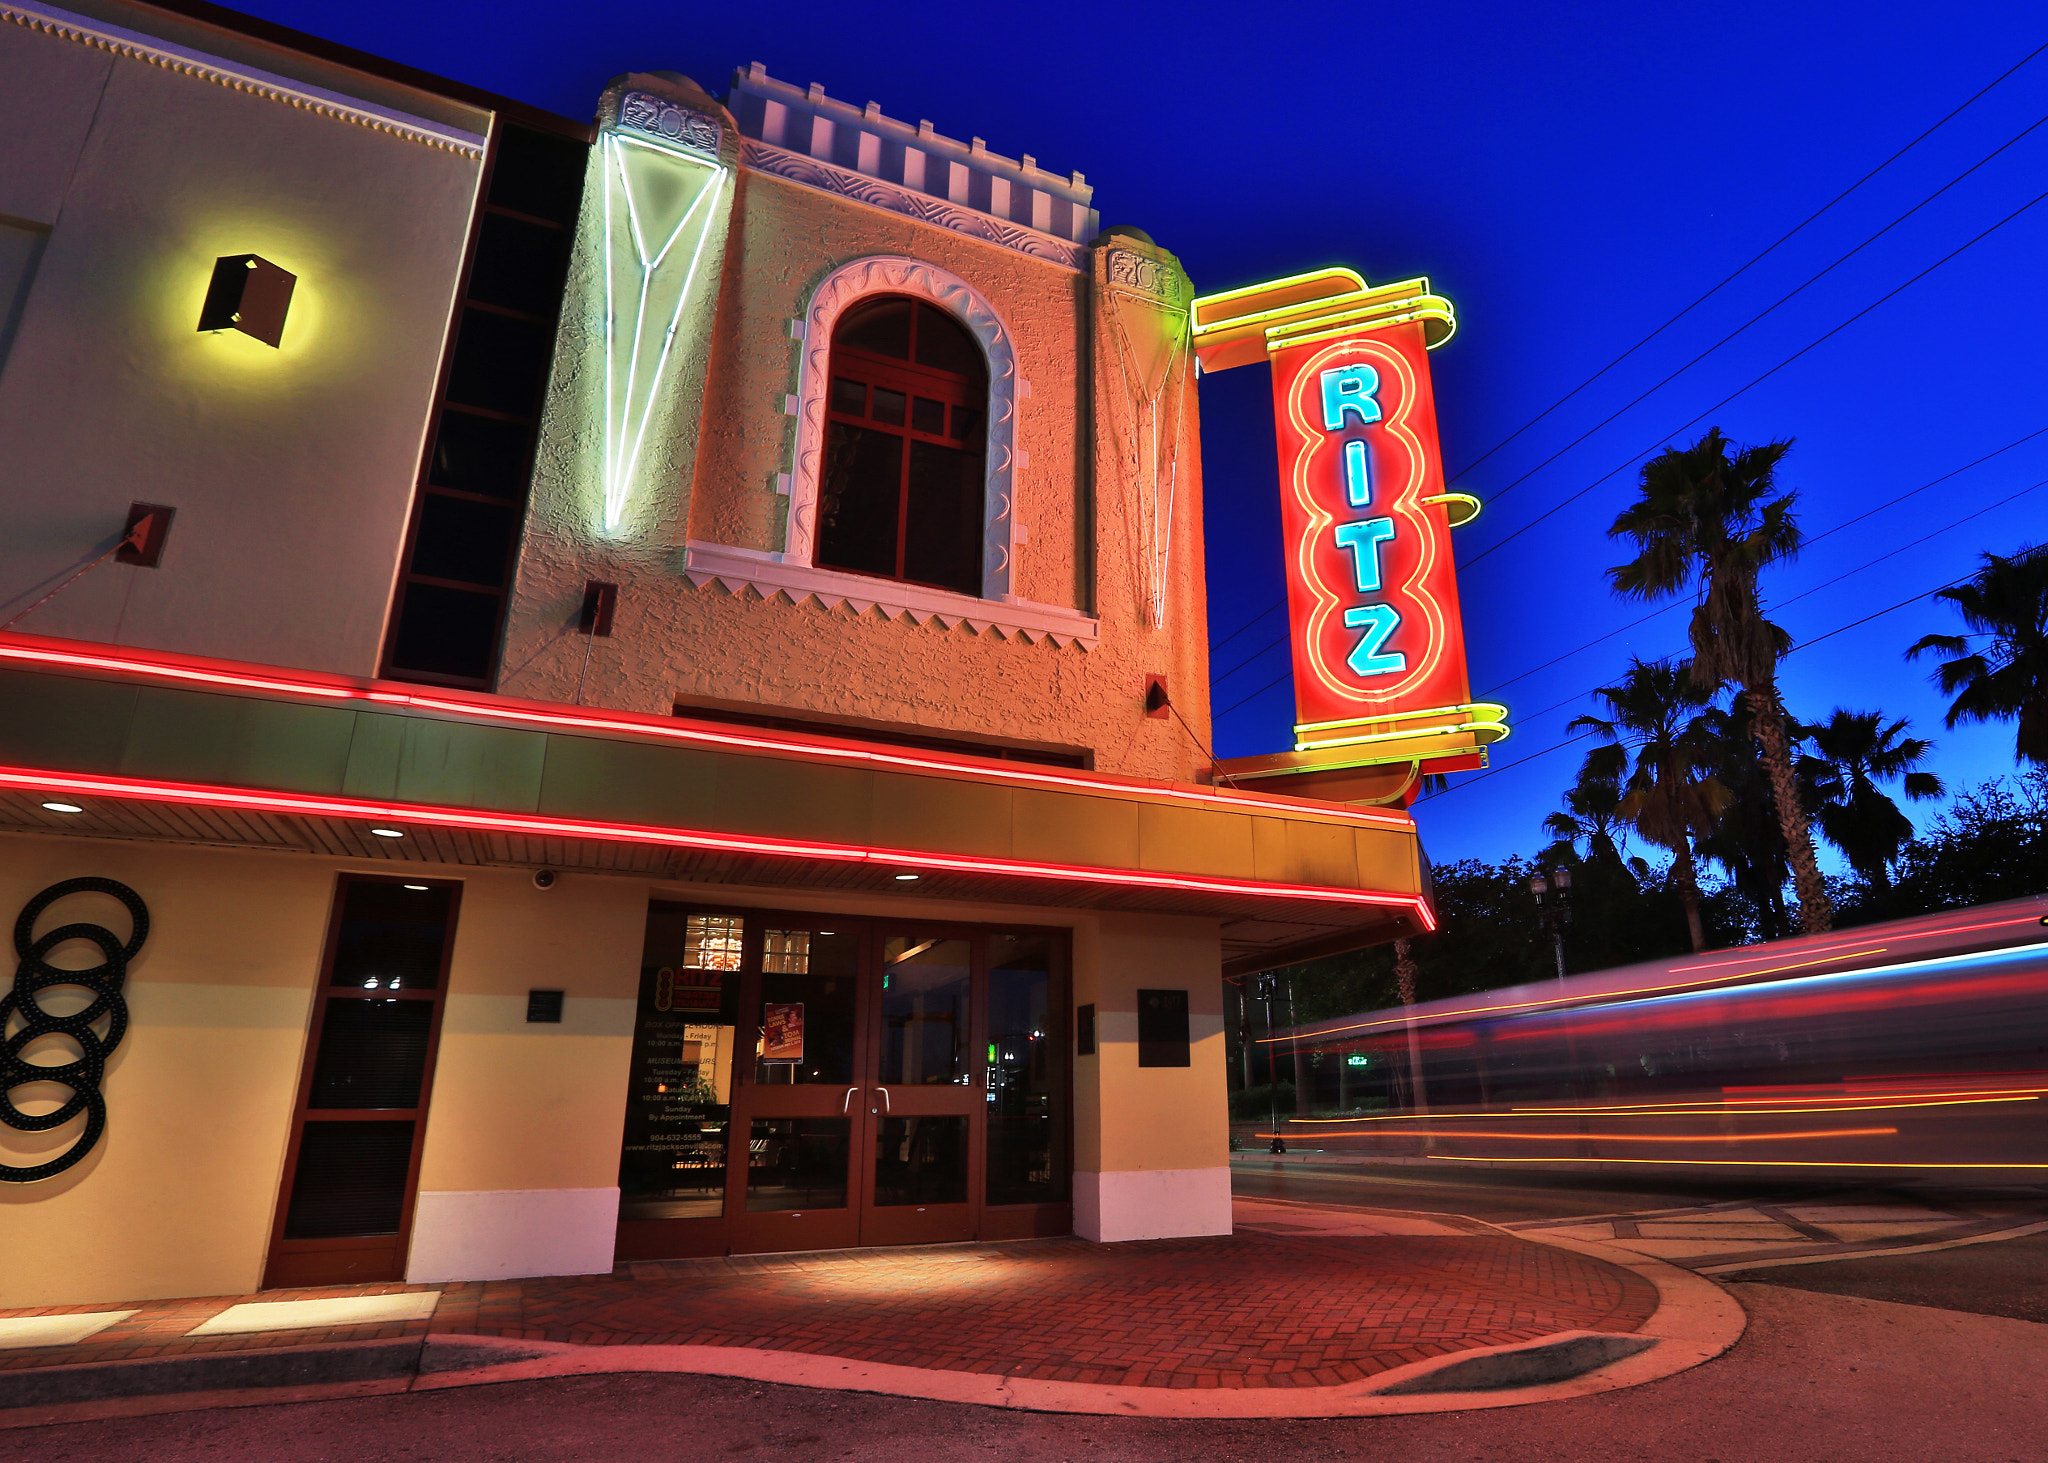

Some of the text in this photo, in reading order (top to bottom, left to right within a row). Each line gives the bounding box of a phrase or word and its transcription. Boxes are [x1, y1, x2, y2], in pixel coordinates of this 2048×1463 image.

[1319, 362, 1408, 677] RITZ
[674, 968, 723, 986] RITZ
[768, 1019, 786, 1028] LAWS
[781, 1025, 789, 1033] &
[690, 1032, 712, 1040] Friday
[783, 1030, 800, 1039] TOM
[646, 1057, 683, 1065] MUSEUM
[652, 1069, 682, 1077] Tuesday
[664, 1106, 692, 1114] Sunday
[648, 1114, 706, 1122] By Appointment
[649, 1134, 702, 1142] 904-632-5555
[624, 1142, 724, 1152] www.ritzjacksonville.com
